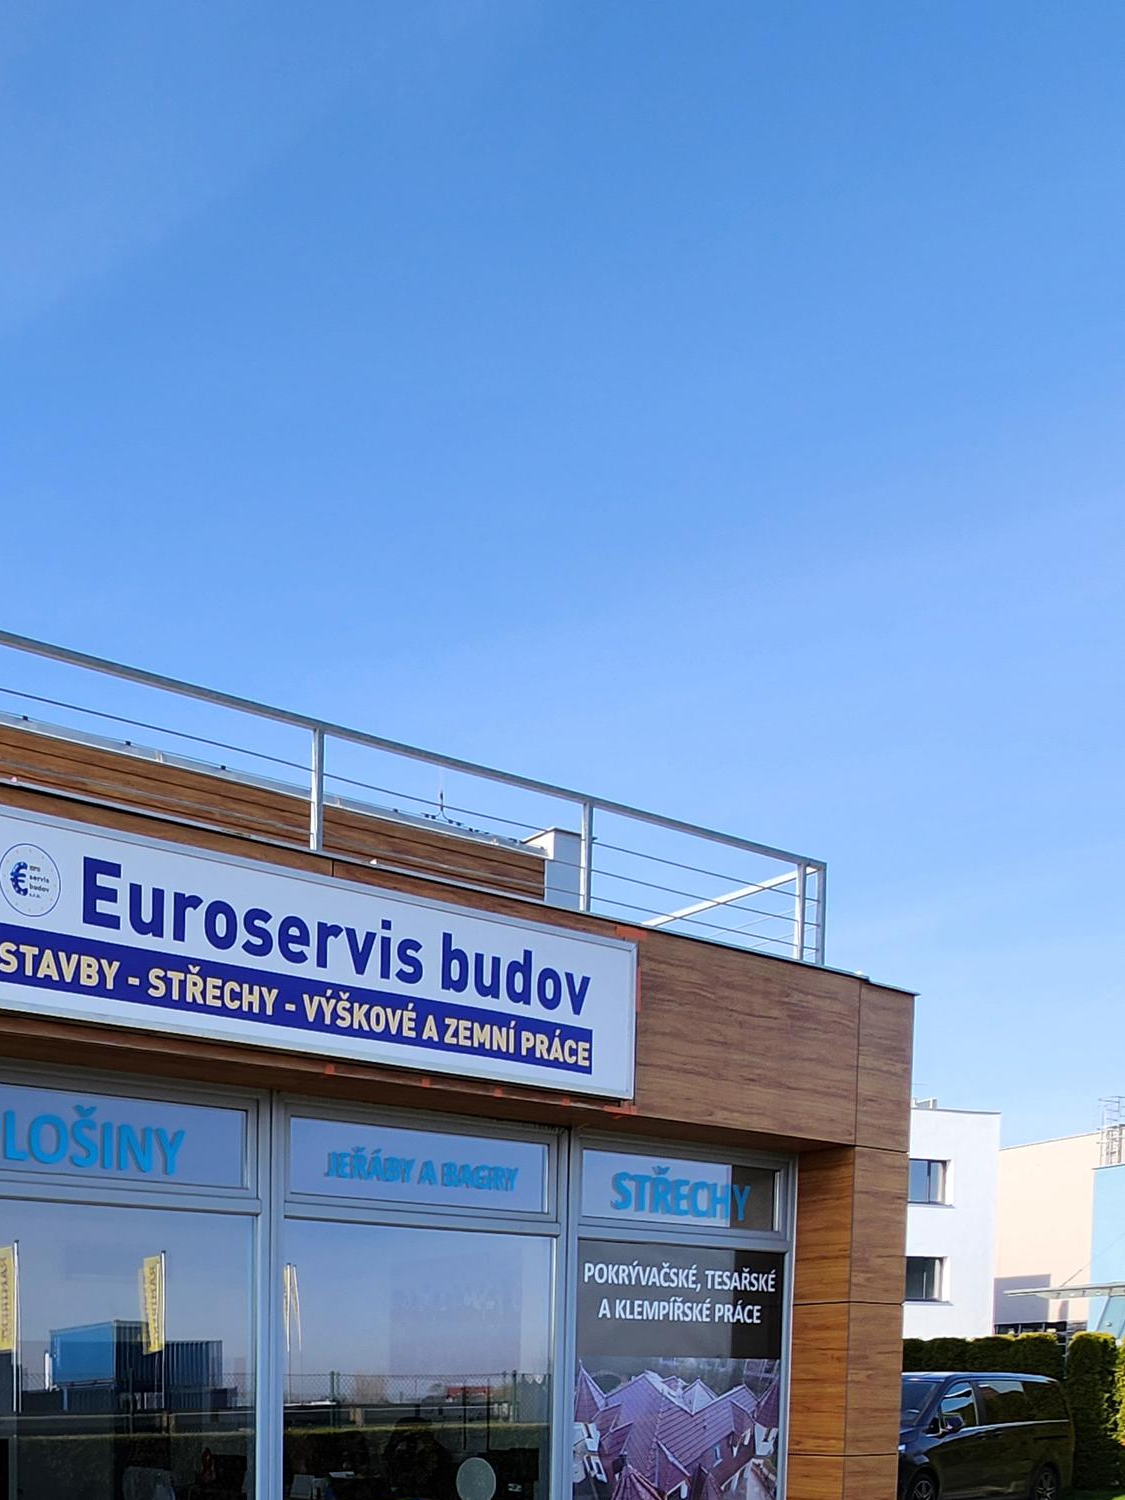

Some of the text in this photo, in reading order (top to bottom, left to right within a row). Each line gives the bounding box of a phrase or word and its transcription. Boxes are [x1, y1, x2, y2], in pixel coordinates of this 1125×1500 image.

[29, 883, 50, 893] budov
[83, 856, 591, 1015] Euroservis budov
[148, 966, 279, 1017] STŘECHY
[302, 989, 417, 1038] VÝŠKOVÉ
[422, 1022, 438, 1041] A
[444, 1018, 517, 1054] ZEMNÍ
[521, 1029, 591, 1067] PRÁCE
[324, 1146, 519, 1192] JEŘÁBY A BAGRY
[611, 1166, 751, 1222] STŘECHY
[583, 1261, 776, 1293] POKRÝVAČSKÉ, TESAŘSKÉ
[599, 1296, 761, 1324] A KLEMPÍŘSKÉ PRÁCE
